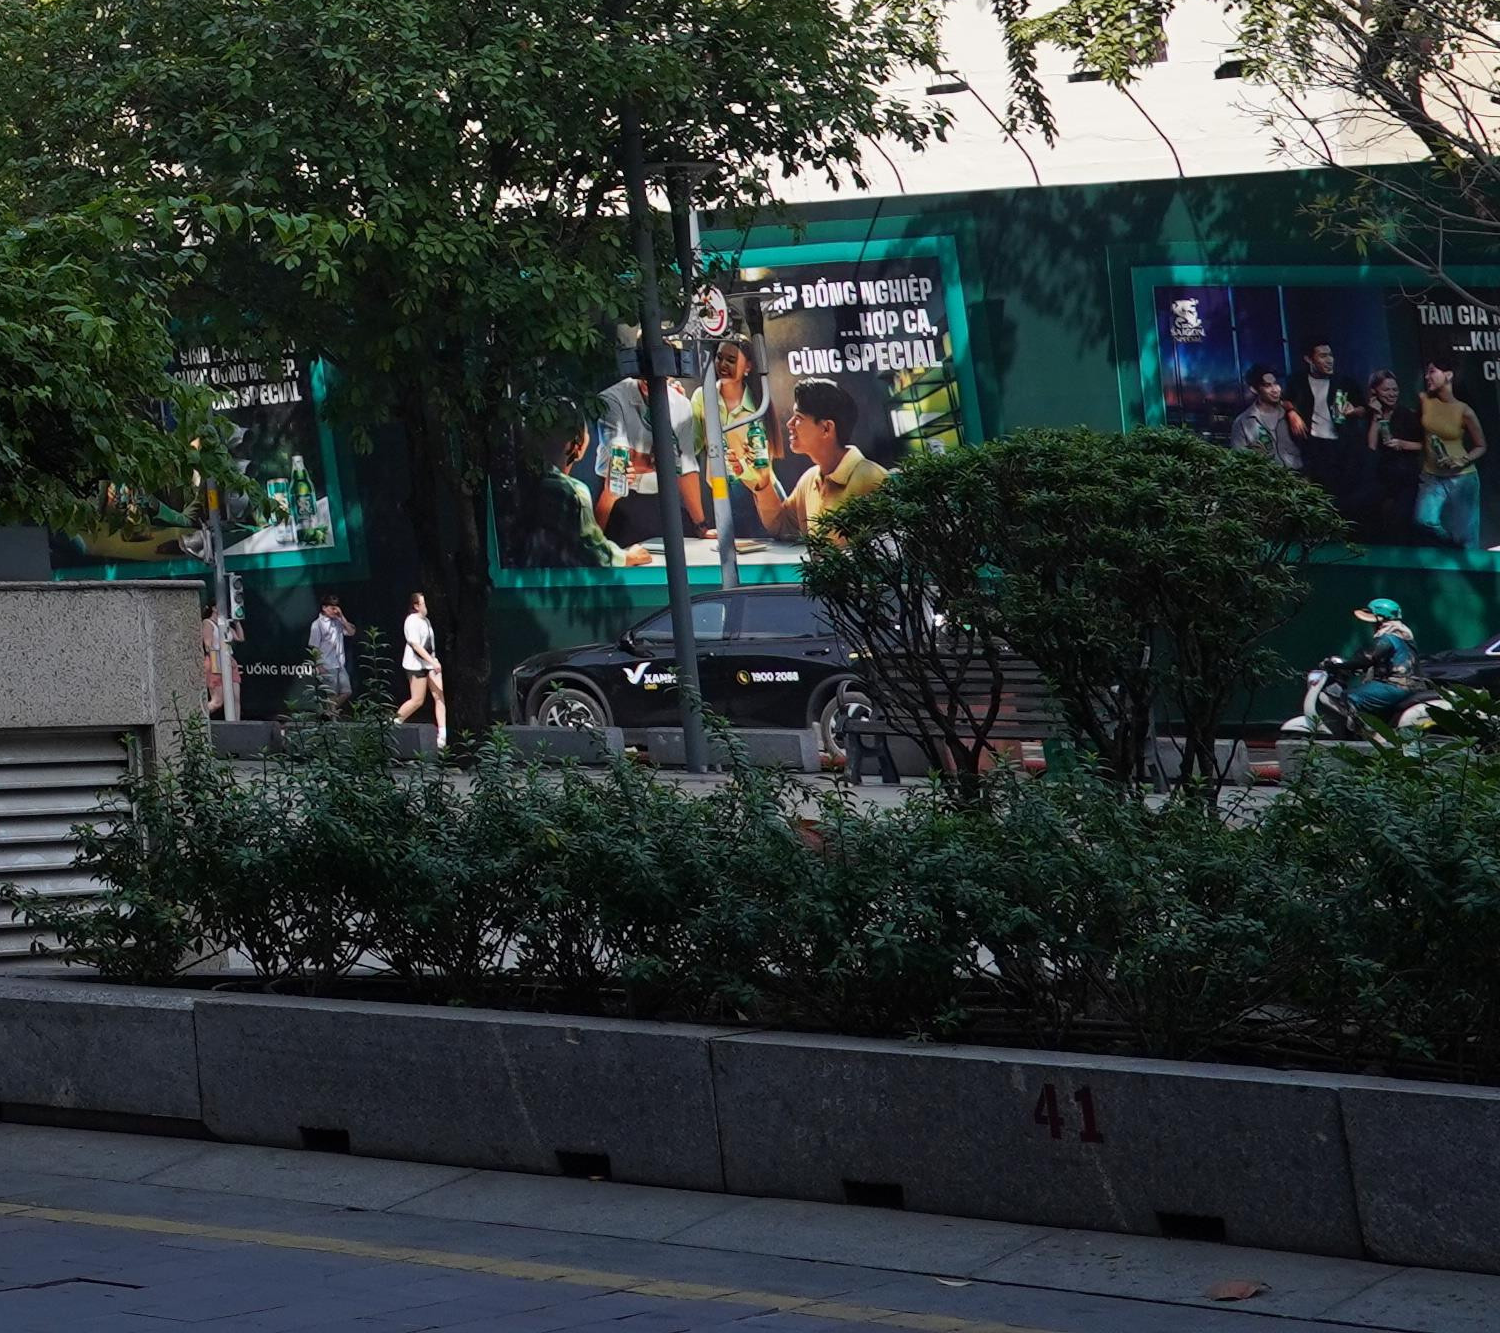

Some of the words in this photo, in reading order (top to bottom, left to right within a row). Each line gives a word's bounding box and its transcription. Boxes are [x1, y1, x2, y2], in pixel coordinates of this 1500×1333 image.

[801, 277, 857, 308] ĐỒNG
[859, 273, 933, 306] NGHIỆP
[1457, 305, 1489, 326] GIA
[787, 346, 843, 376] CŨNG
[845, 339, 943, 372] SPECIAL
[241, 380, 303, 408] SPECIAL
[246, 661, 278, 675] UỐNG
[751, 671, 774, 683] 1900
[1034, 1082, 1104, 1144] 41
